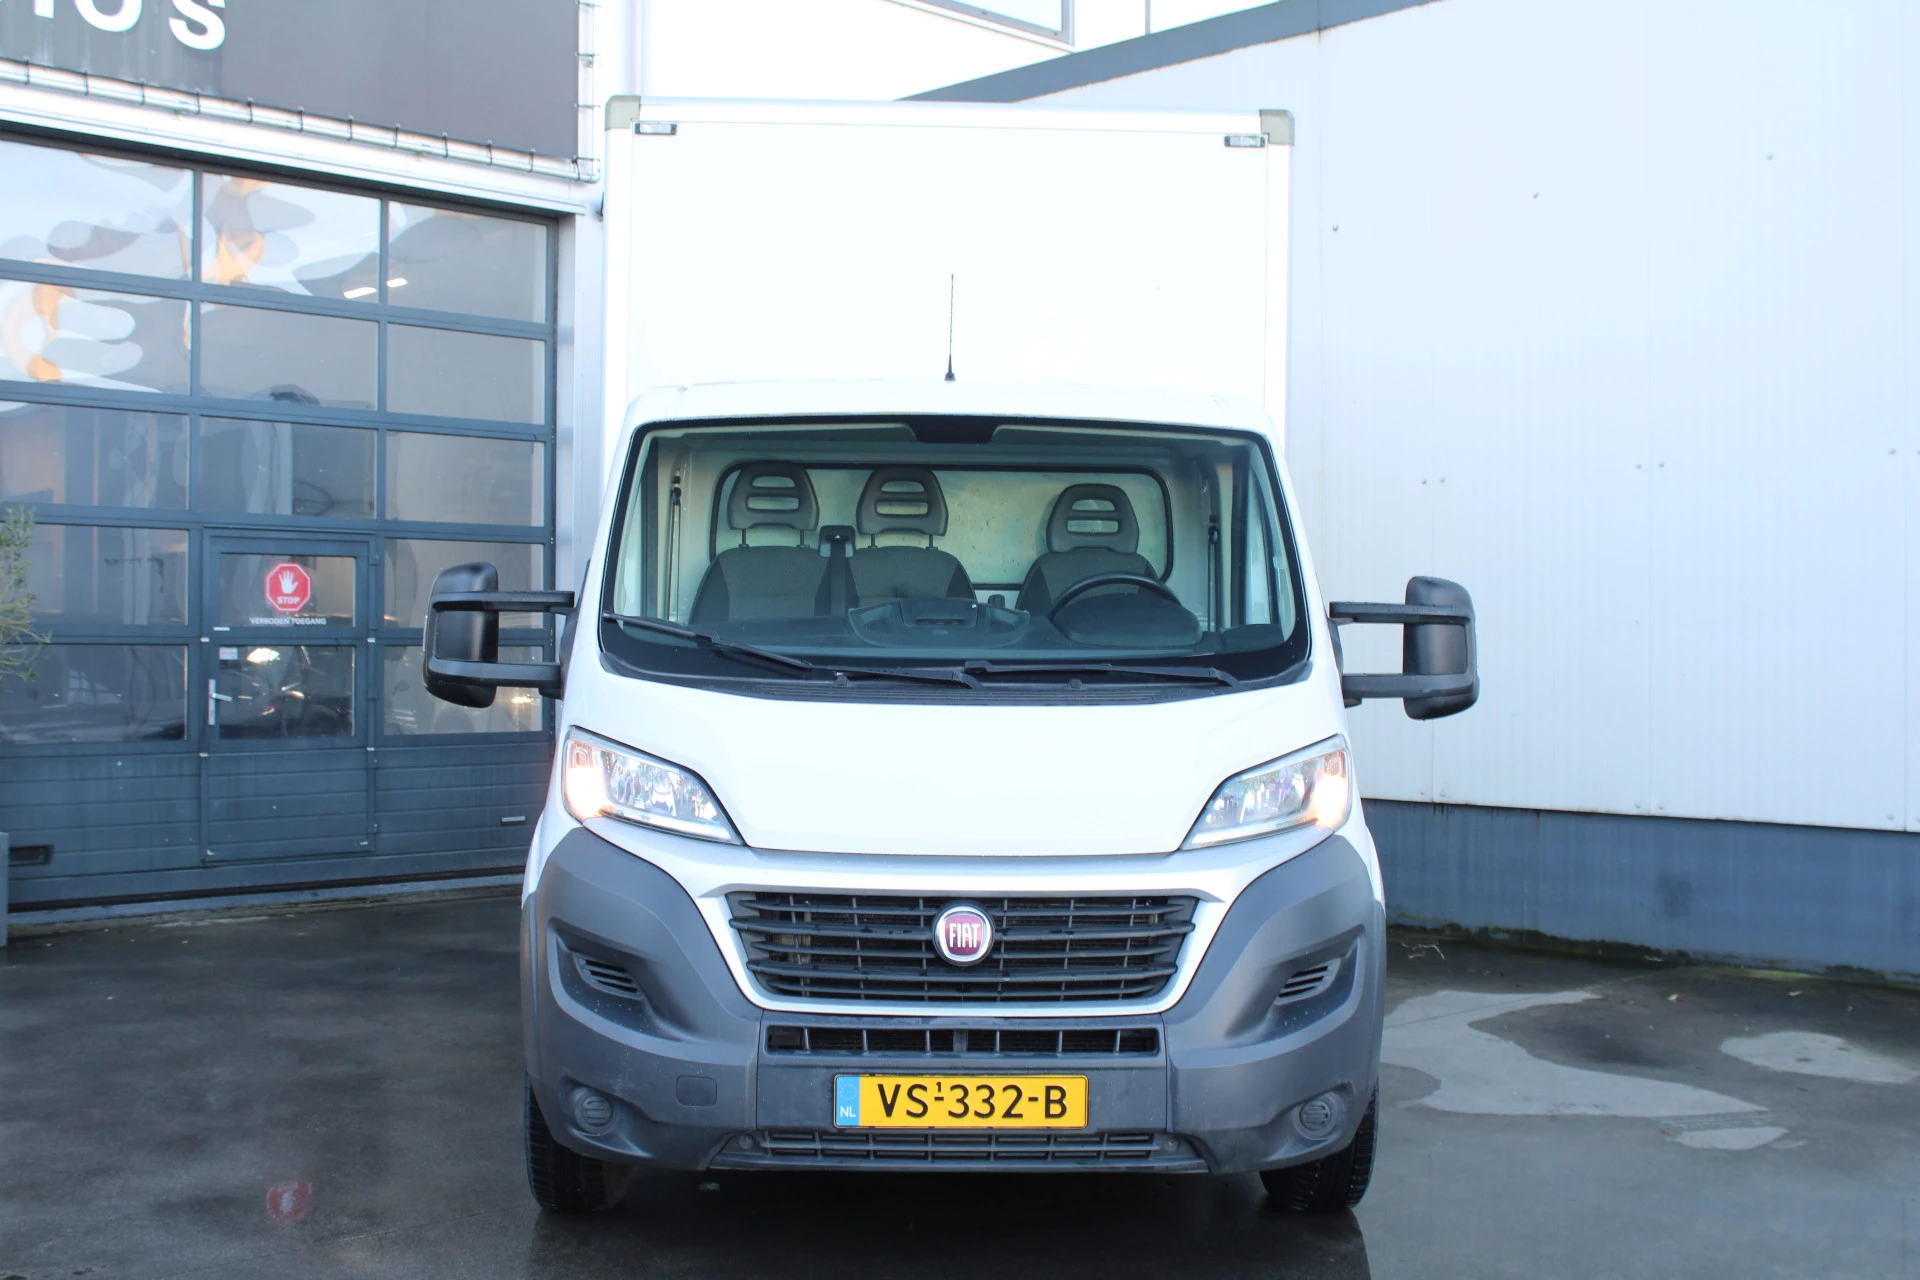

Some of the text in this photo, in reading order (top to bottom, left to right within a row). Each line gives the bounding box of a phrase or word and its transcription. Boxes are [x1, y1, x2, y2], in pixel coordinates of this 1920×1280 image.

[277, 596, 300, 604] STOP
[250, 617, 327, 625] VERBODEN TOEGANG
[949, 922, 980, 948] FIAT
[839, 1106, 856, 1118] NL
